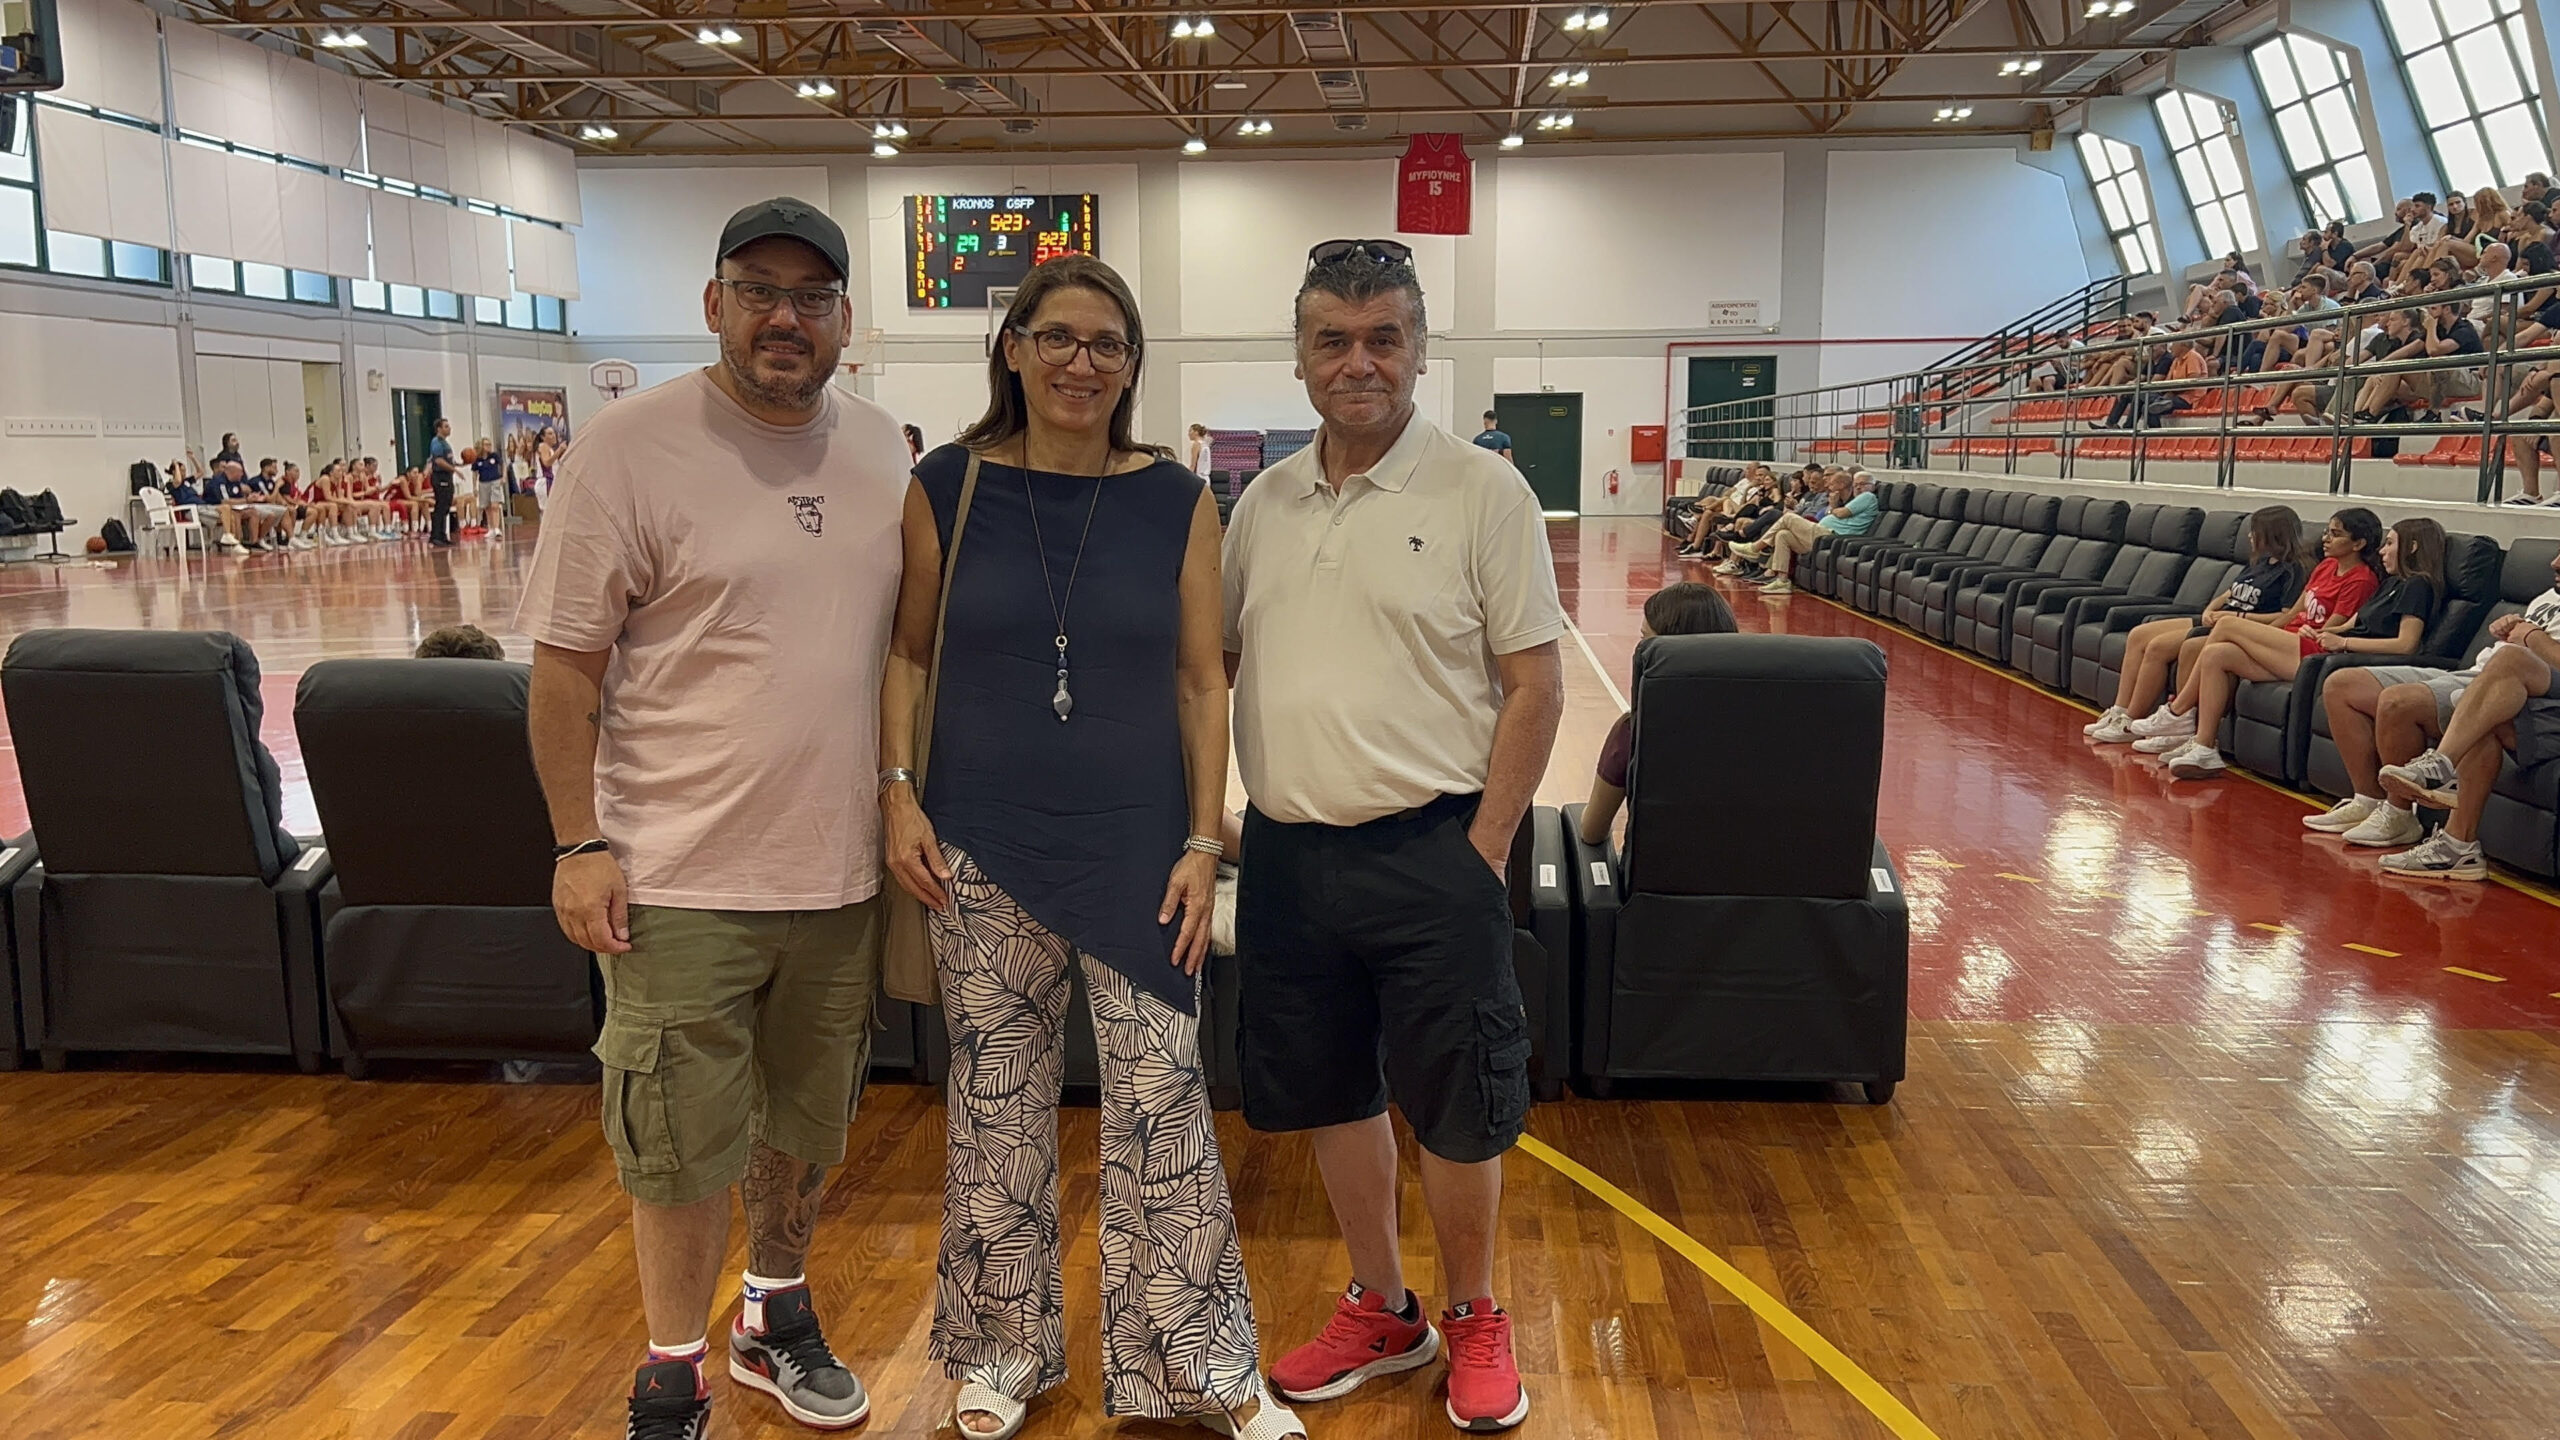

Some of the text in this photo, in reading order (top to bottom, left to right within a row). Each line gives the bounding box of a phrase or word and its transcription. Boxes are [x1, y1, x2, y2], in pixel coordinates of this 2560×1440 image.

[1408, 170, 1461, 183] ΜΥΡΙΟΥΝΗΣ
[1429, 181, 1442, 195] 15
[953, 198, 1035, 210] KRONOS GSFP
[990, 214, 1023, 231] 5:23
[956, 231, 1068, 252] 29 3 5:23
[954, 256, 964, 270] 2
